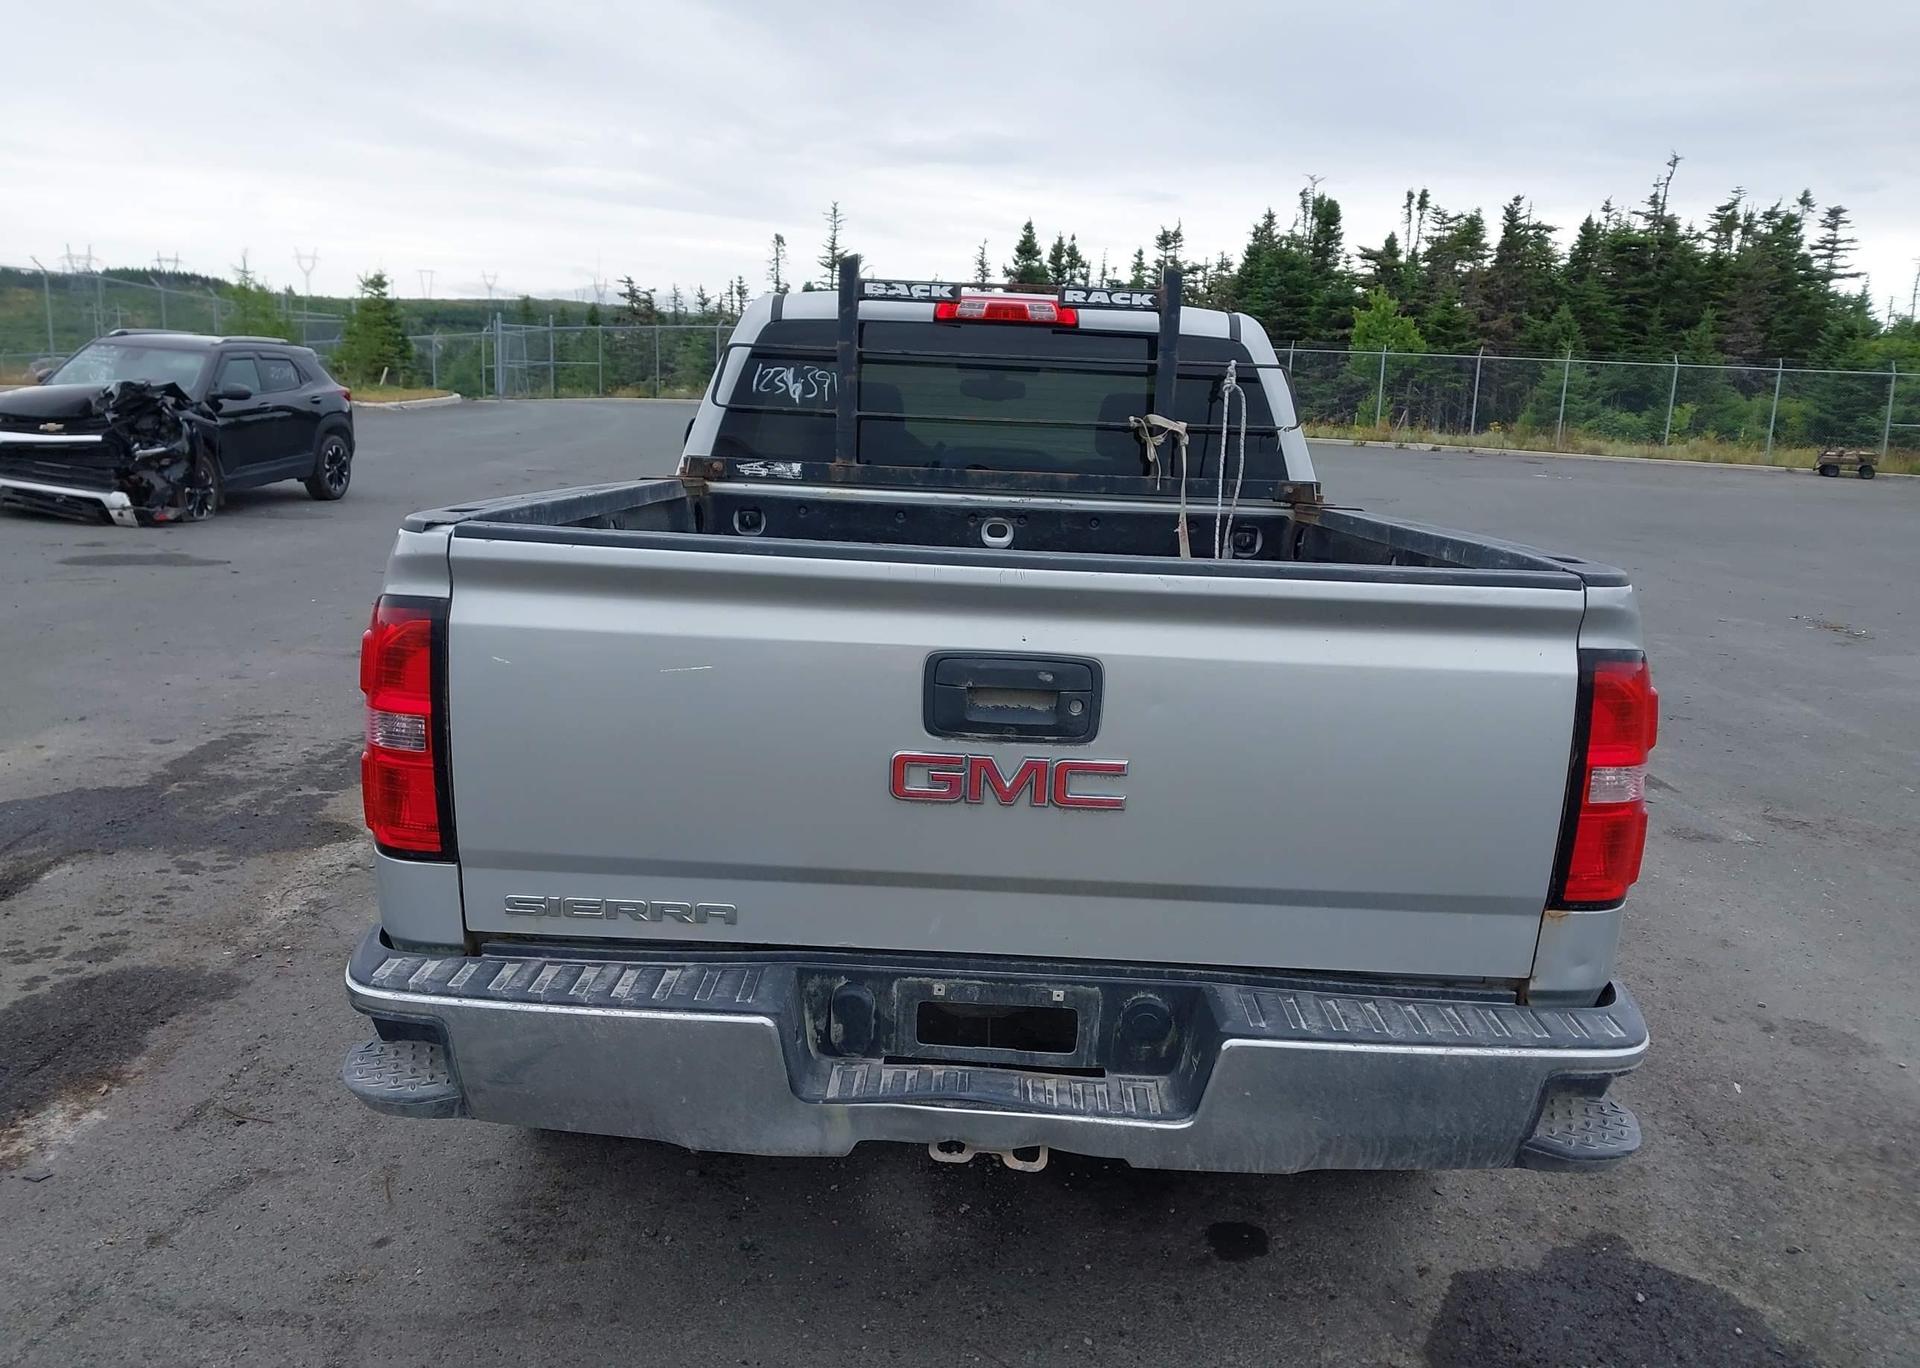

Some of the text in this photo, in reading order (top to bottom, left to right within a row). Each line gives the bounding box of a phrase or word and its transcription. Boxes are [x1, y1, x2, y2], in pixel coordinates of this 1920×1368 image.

[864, 282, 1154, 306] BACK RACK
[889, 750, 1128, 810] GMC
[504, 894, 738, 925] SIERRA
